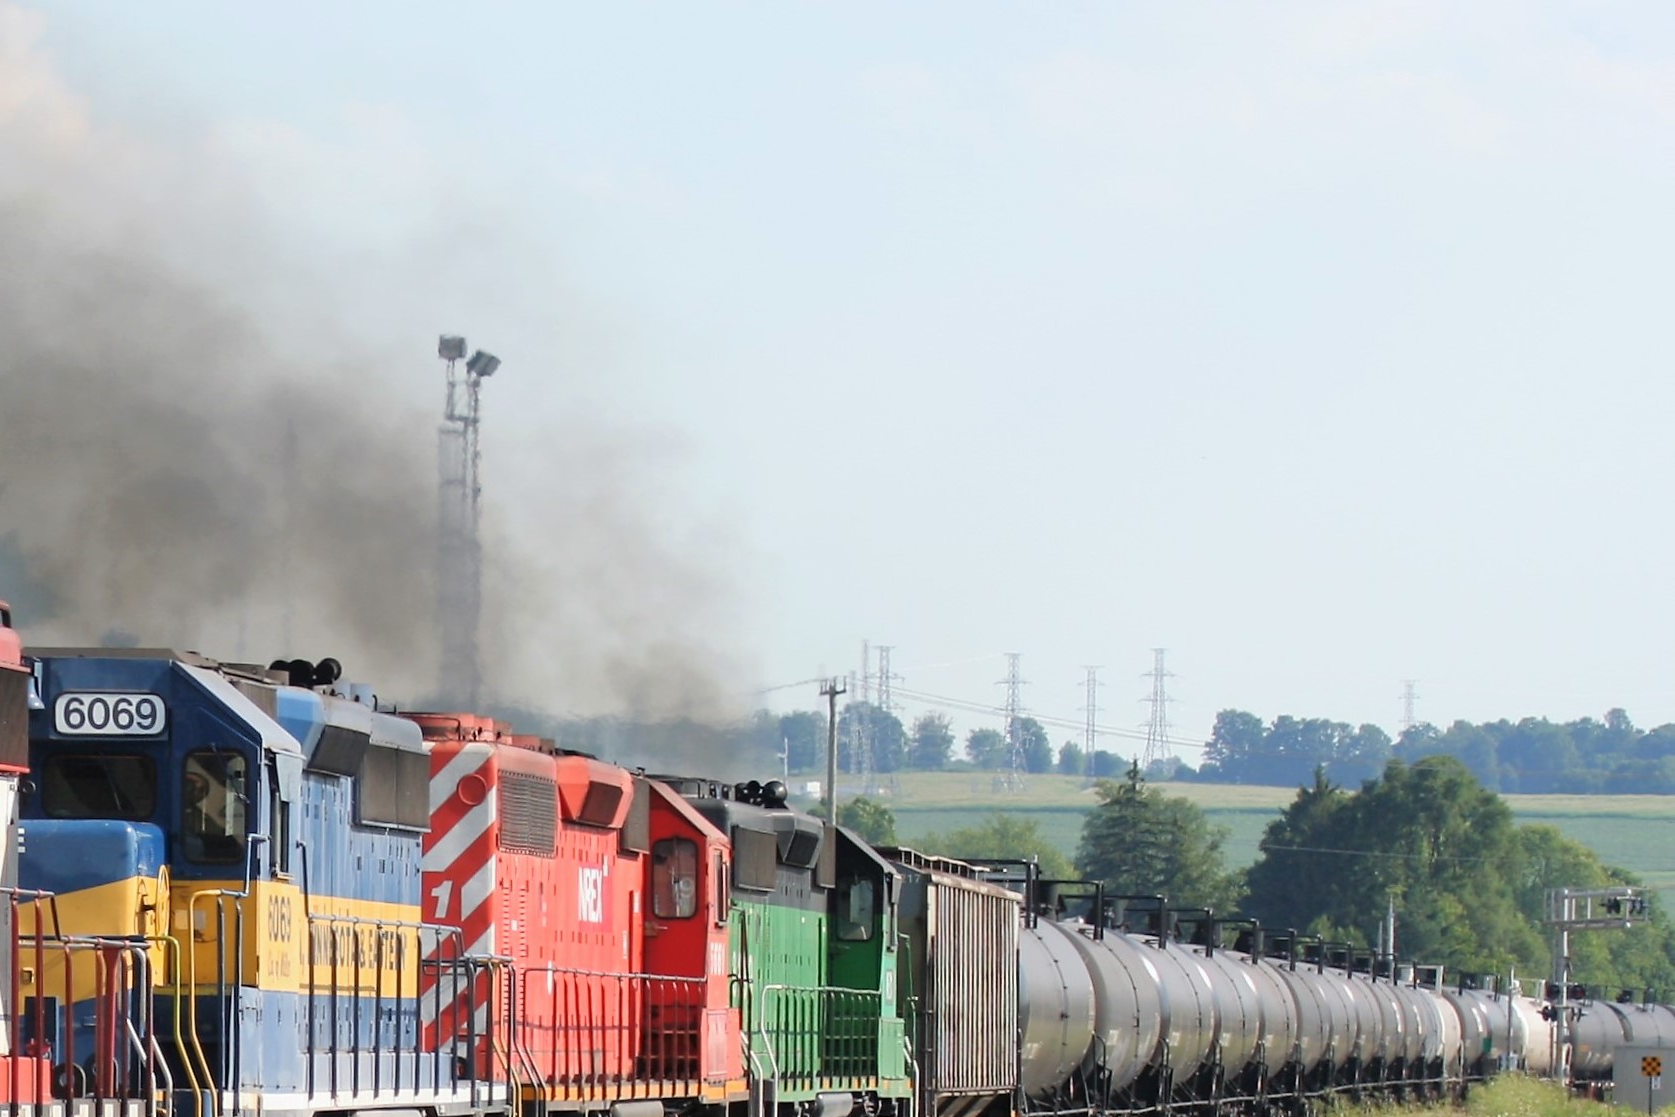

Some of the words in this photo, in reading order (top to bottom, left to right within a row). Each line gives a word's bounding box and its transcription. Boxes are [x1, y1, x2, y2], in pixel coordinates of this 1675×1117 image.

[63, 697, 157, 730] 6069
[578, 866, 603, 923] NREX
[268, 894, 292, 943] 6069
[369, 928, 407, 971] EASTEN
